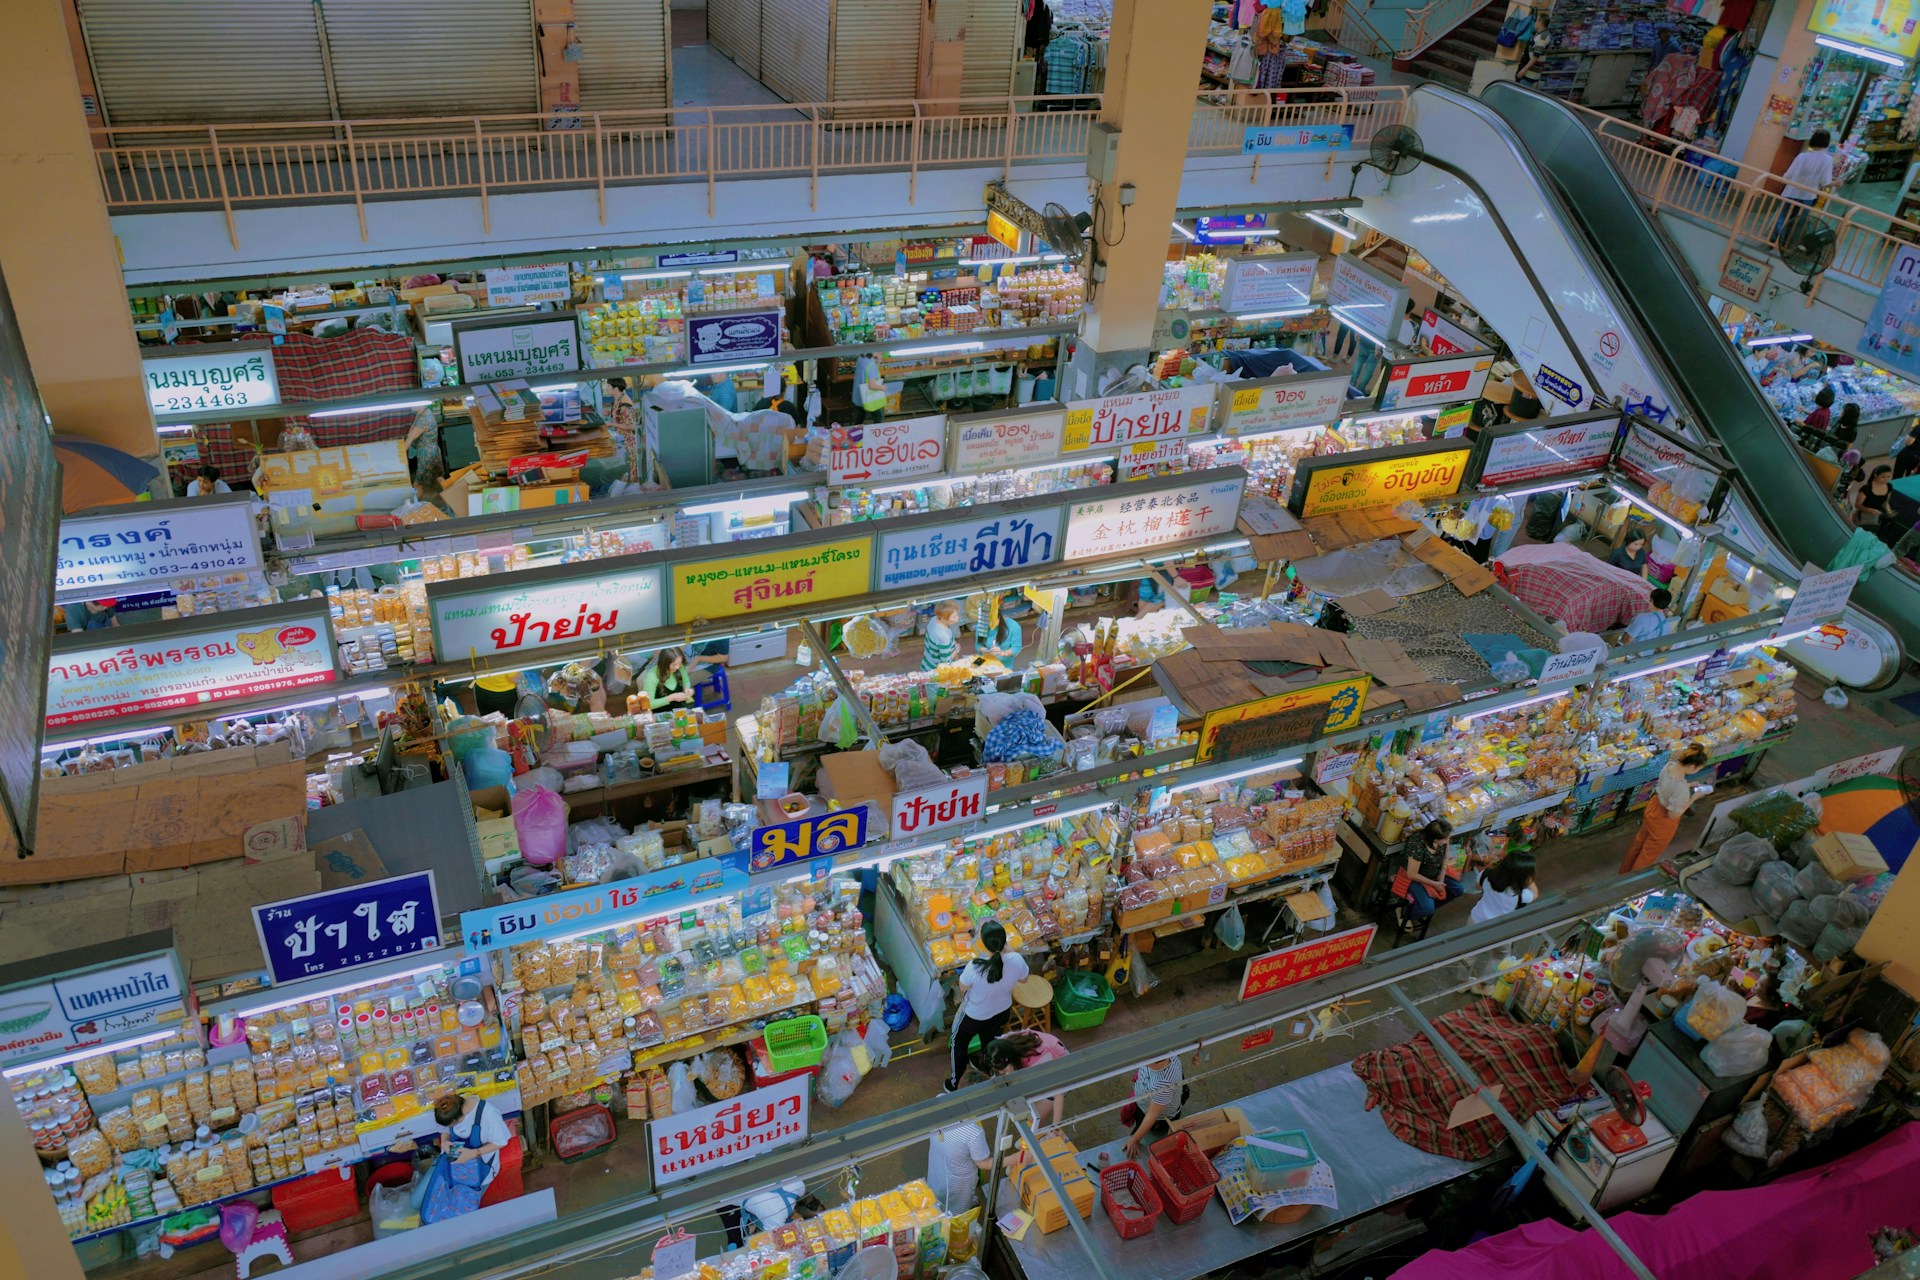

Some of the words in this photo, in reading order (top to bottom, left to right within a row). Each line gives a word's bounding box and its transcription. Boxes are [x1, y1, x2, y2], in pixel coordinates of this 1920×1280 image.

[1257, 133, 1272, 146] ชิม
[1298, 130, 1310, 145] ใช้
[468, 338, 571, 367] แหนมบุญศรี
[146, 357, 265, 394] นมบุญศรี
[495, 369, 514, 378] 053
[525, 363, 565, 375] 234463
[1393, 367, 1406, 378] ร้าน
[1423, 374, 1452, 394] หล้า
[1103, 397, 1133, 409] แหนม
[1149, 390, 1180, 405] หมูยอ
[1275, 389, 1307, 404] จอย
[994, 424, 1031, 438] จอย
[1090, 404, 1182, 445] ป้าย่น
[831, 436, 940, 471] แกงฮังเล
[1384, 463, 1456, 491] อัญชัญ
[1119, 492, 1199, 514] 经营泰北食品
[88, 550, 146, 566] แคบหมู
[158, 538, 243, 560] น้ำพริกหนุ่ม
[887, 533, 968, 569] กุนเชียง
[969, 518, 1053, 573] มีฟ้า
[116, 570, 146, 580] บ้าน
[149, 556, 246, 576] 053-491042
[733, 570, 816, 609] สุจินต์
[490, 603, 619, 649] ป้าย่น
[49, 641, 237, 681] านศรีพรรณ
[56, 689, 130, 709] น้ำพริกหนุ่ม
[139, 675, 216, 697] หมูกรอบแก้ว
[224, 688, 240, 696] Line
[897, 788, 981, 832] ป้าย่น
[267, 908, 292, 921] ร้าน
[498, 914, 537, 936] ชิม
[543, 897, 601, 925] ช้อป
[608, 887, 639, 910] ใช้
[284, 900, 420, 960] ป้าใส
[304, 962, 325, 974] โทร
[69, 971, 170, 1011] แหนมป้าใส
[658, 1094, 801, 1156] เหมียว
[662, 1121, 801, 1174] แหนมป้าย่น
